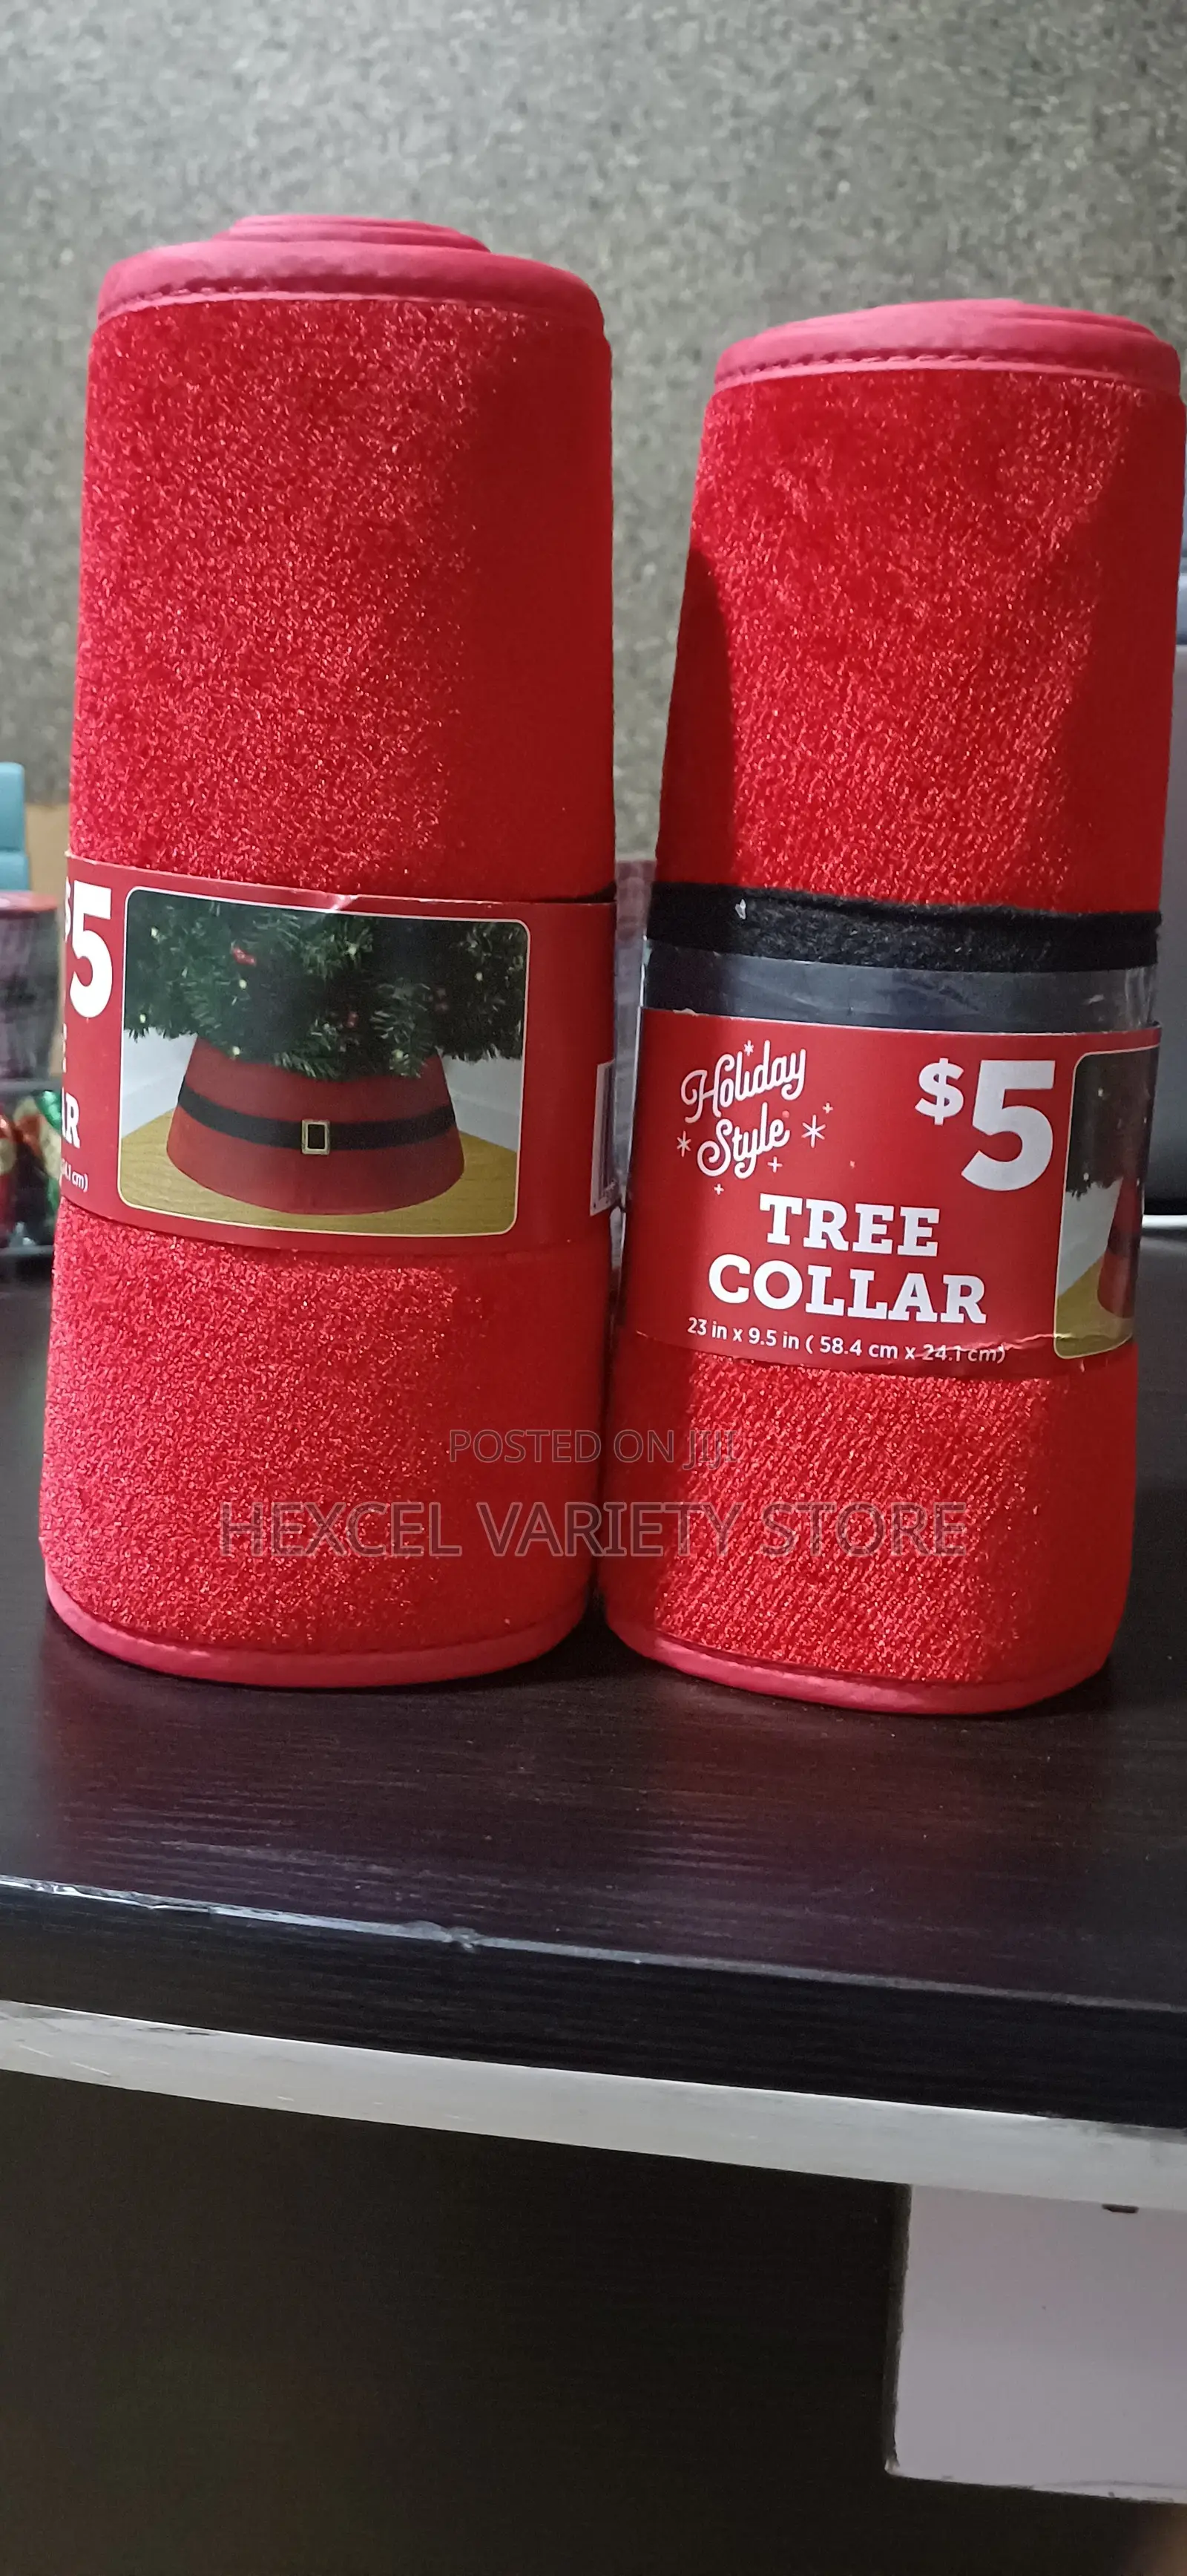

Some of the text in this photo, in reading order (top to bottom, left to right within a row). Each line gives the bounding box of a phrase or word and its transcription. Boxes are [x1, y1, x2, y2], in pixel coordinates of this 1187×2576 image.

[680, 1040, 806, 1124] Holiday
[697, 1102, 790, 1179] Style
[914, 1058, 1056, 1191] $5
[759, 1193, 940, 1256] TREE
[708, 1254, 987, 1324] COLLAR
[687, 1317, 707, 1336] 23
[711, 1320, 728, 1340] in
[732, 1328, 743, 1342] x
[748, 1327, 777, 1347] 9.5
[783, 1331, 800, 1350] in
[819, 1335, 863, 1356] 58.4
[868, 1344, 898, 1359] cm
[904, 1346, 916, 1360] x
[922, 1344, 961, 1362] 24.1
[967, 1344, 1006, 1364] cm)
